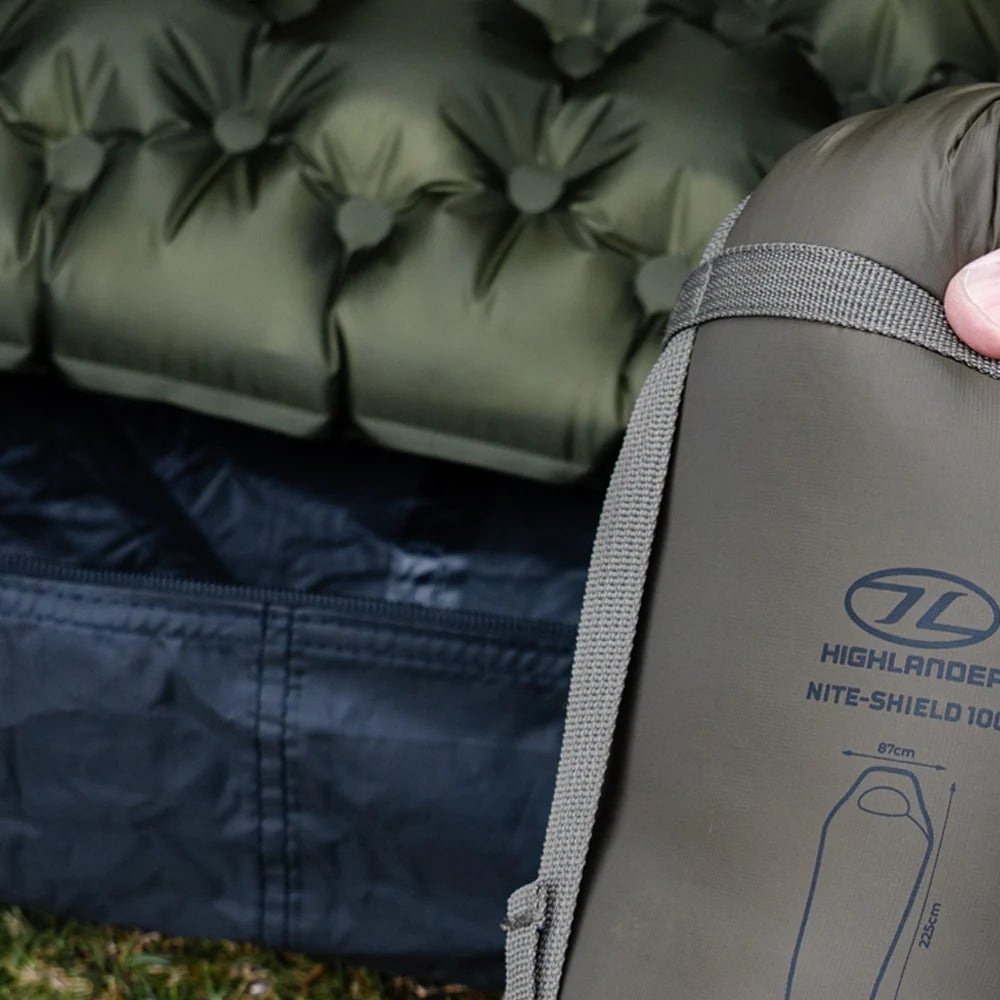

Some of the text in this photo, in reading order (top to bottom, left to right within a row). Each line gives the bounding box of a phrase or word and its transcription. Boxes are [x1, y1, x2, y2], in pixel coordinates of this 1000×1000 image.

[806, 681, 962, 723] NITE-SHIELD
[877, 742, 916, 759] 87cm
[919, 902, 942, 949] 225cm
